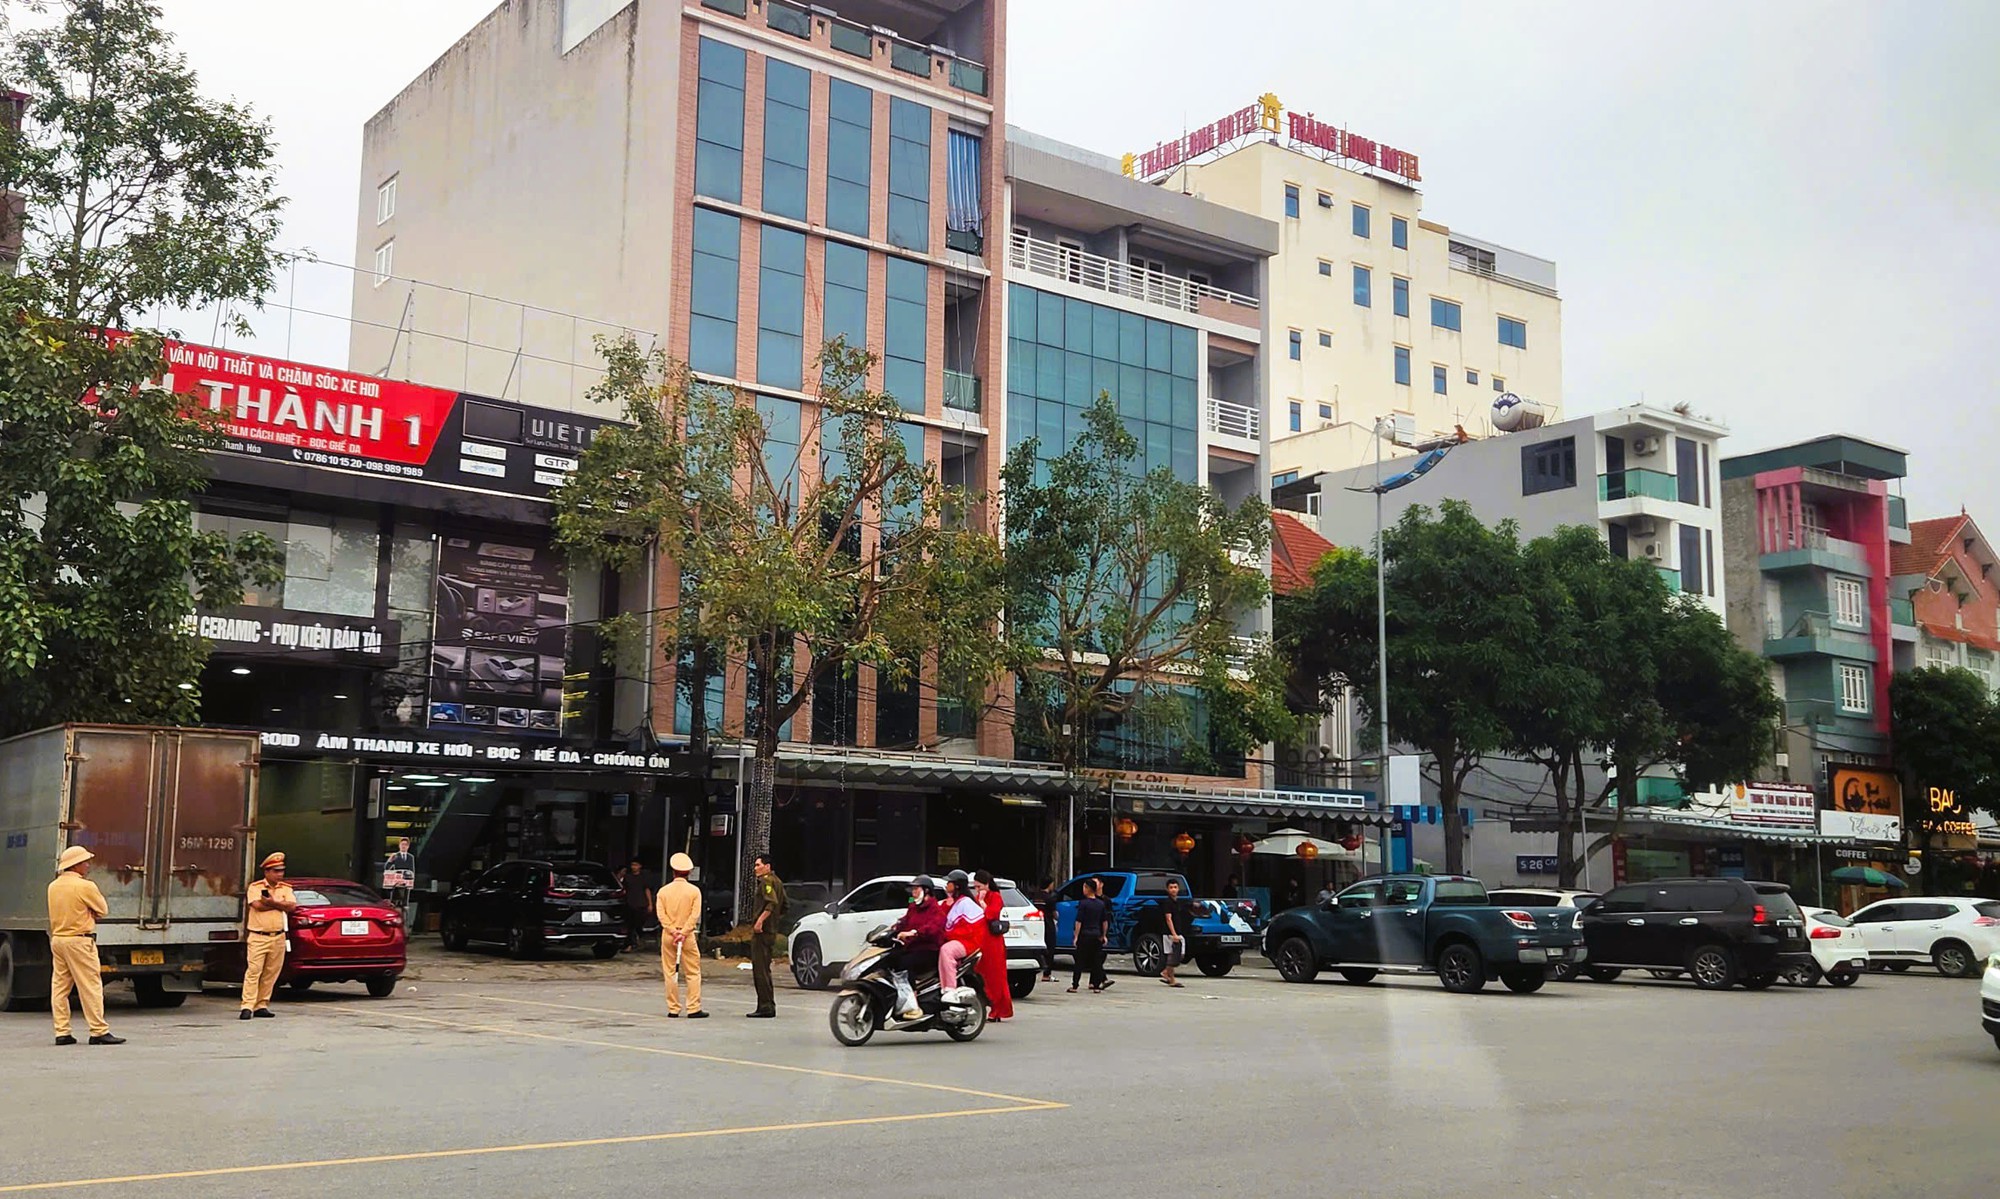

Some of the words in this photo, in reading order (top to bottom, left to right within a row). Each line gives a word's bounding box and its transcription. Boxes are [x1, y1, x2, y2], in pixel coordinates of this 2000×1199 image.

[1217, 103, 1258, 145] HOTEL
[1287, 111, 1337, 153] THĂNG
[1340, 129, 1377, 167] LONG
[1380, 144, 1422, 182] HOTEL
[169, 343, 194, 366] VẤN
[198, 351, 219, 372] NỘI
[223, 355, 255, 377] THẤT
[259, 362, 274, 380] VÀ
[277, 366, 312, 387] CHĂM
[315, 373, 339, 391] SÓC
[341, 378, 357, 394] XE
[359, 381, 380, 399] HƠI
[199, 378, 383, 441] THÀNH
[403, 414, 421, 446] 1
[250, 427, 274, 441] CÁCH
[276, 431, 302, 446] NHIỆT
[309, 437, 327, 450] BỌC
[329, 440, 346, 452] GHẾ
[349, 443, 361, 454] DA
[304, 452, 328, 464] 0786
[384, 463, 401, 474] 989
[402, 466, 423, 477] 1989
[544, 457, 570, 468] GTR
[200, 615, 261, 643] CERAMIC
[271, 623, 299, 650] PHỤ
[300, 622, 331, 650] KIỆN
[332, 626, 360, 651] BÁN
[362, 625, 381, 654] TẢI
[316, 733, 348, 750] ÂM
[352, 737, 412, 754] THANH
[415, 741, 440, 756] XE
[444, 743, 473, 757] HƠI
[486, 746, 521, 762] BỌC
[558, 752, 581, 764] DA
[593, 750, 645, 768] CHỐNG
[1529, 860, 1544, 870] 26
[1835, 848, 1868, 860] COFFEE
